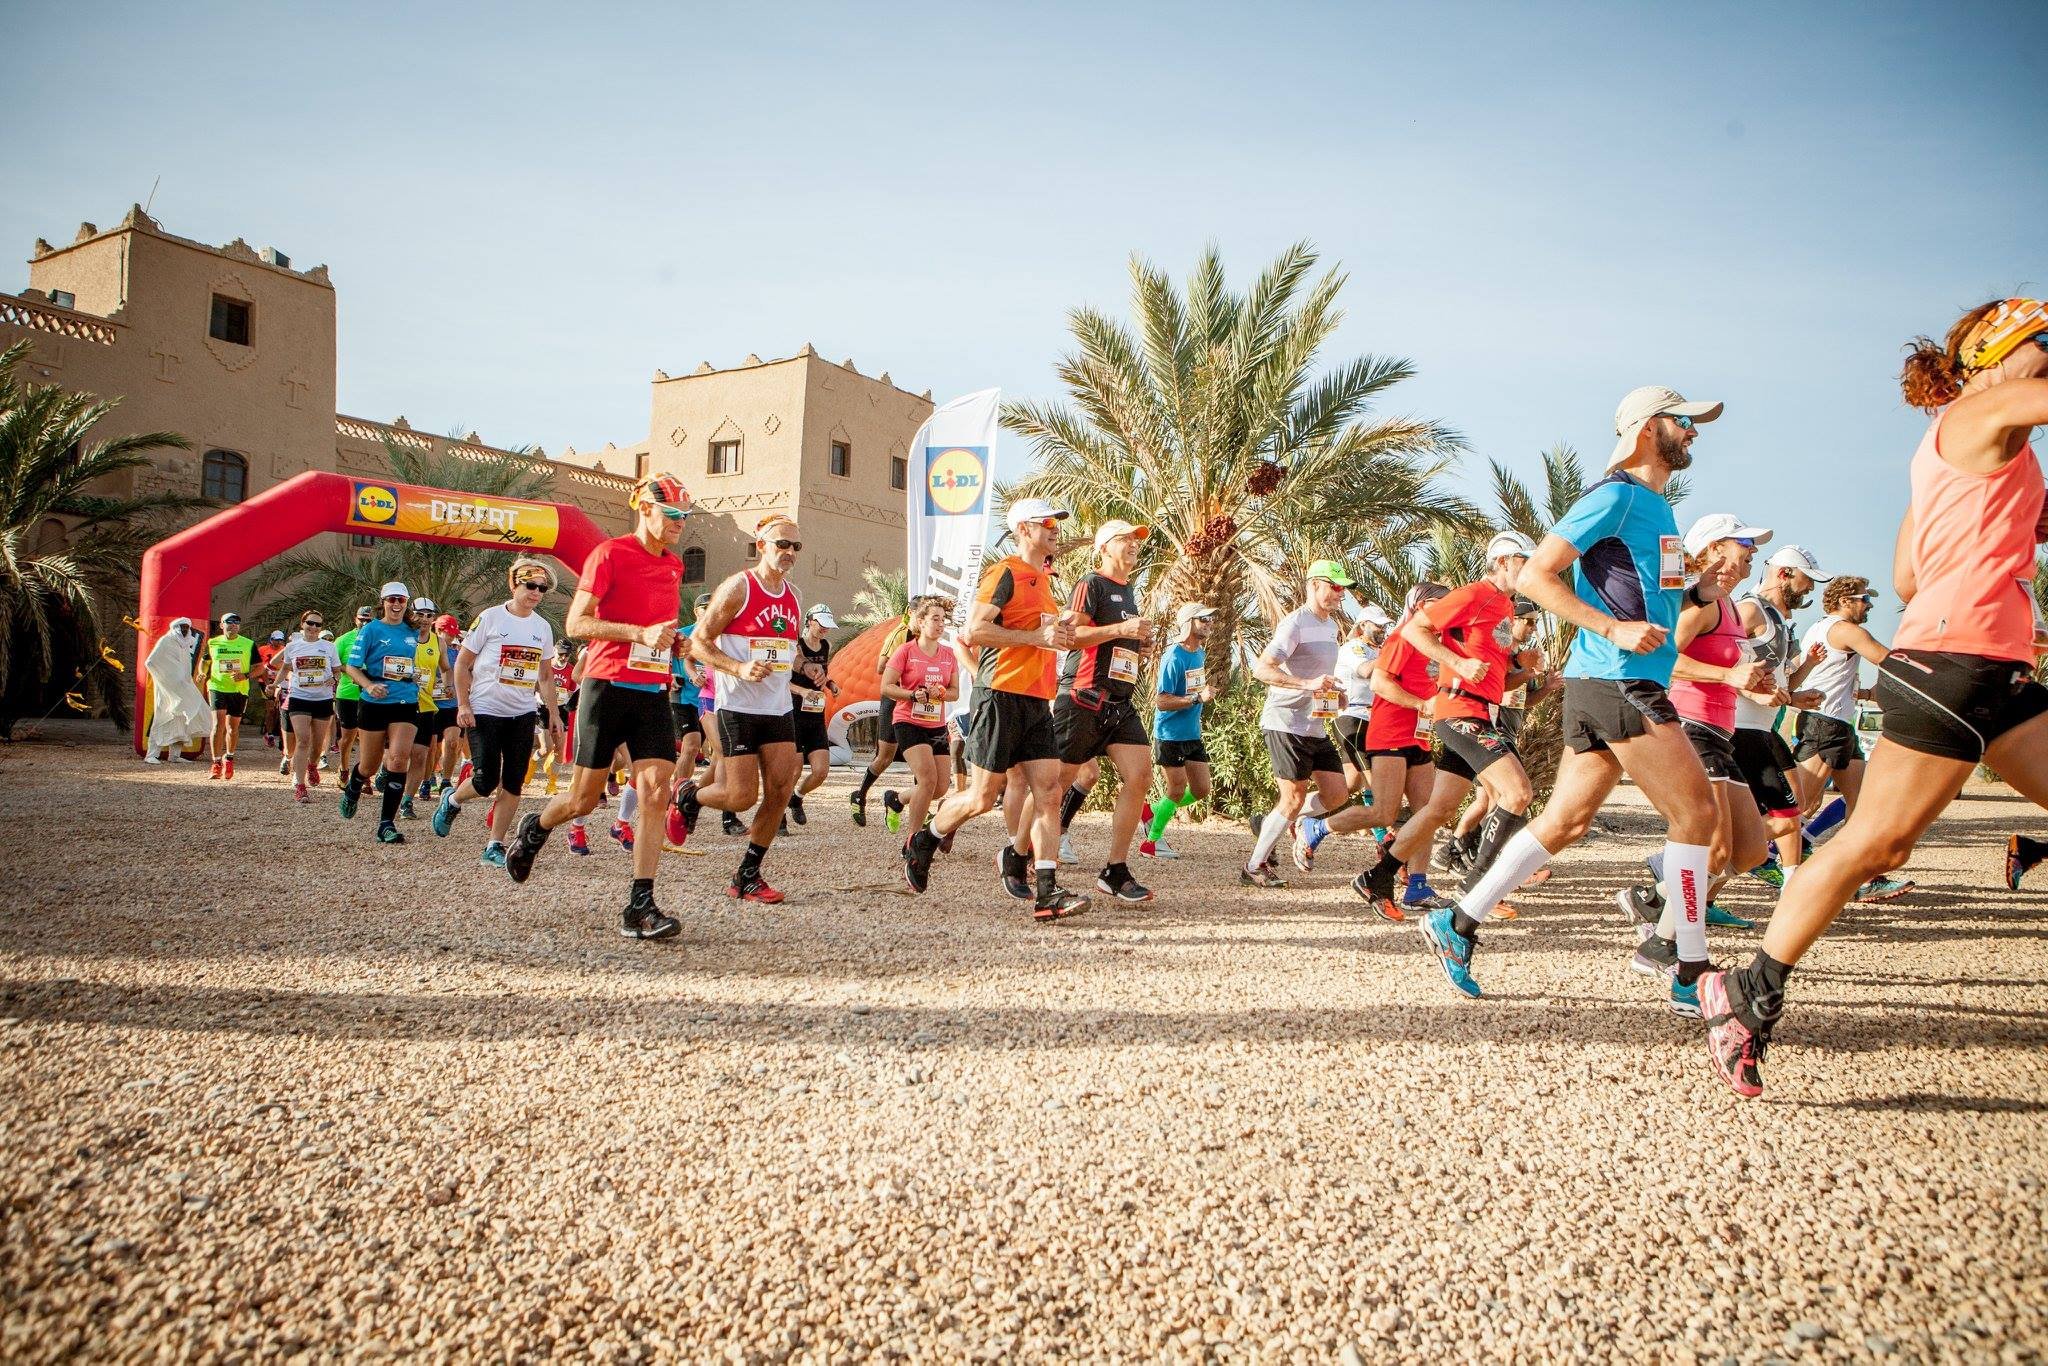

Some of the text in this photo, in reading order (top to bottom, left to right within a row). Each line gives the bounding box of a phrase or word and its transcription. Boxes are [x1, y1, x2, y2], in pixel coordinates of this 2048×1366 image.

[431, 500, 518, 530] DESERT
[500, 529, 535, 545] Run
[967, 544, 981, 568] Lidl
[755, 604, 797, 631] ITALIA
[766, 649, 777, 659] 79
[396, 665, 406, 673] 32
[513, 668, 524, 677] 39
[1486, 815, 1500, 843] 2XU
[1680, 869, 1698, 922] RUNNERSWORLD
